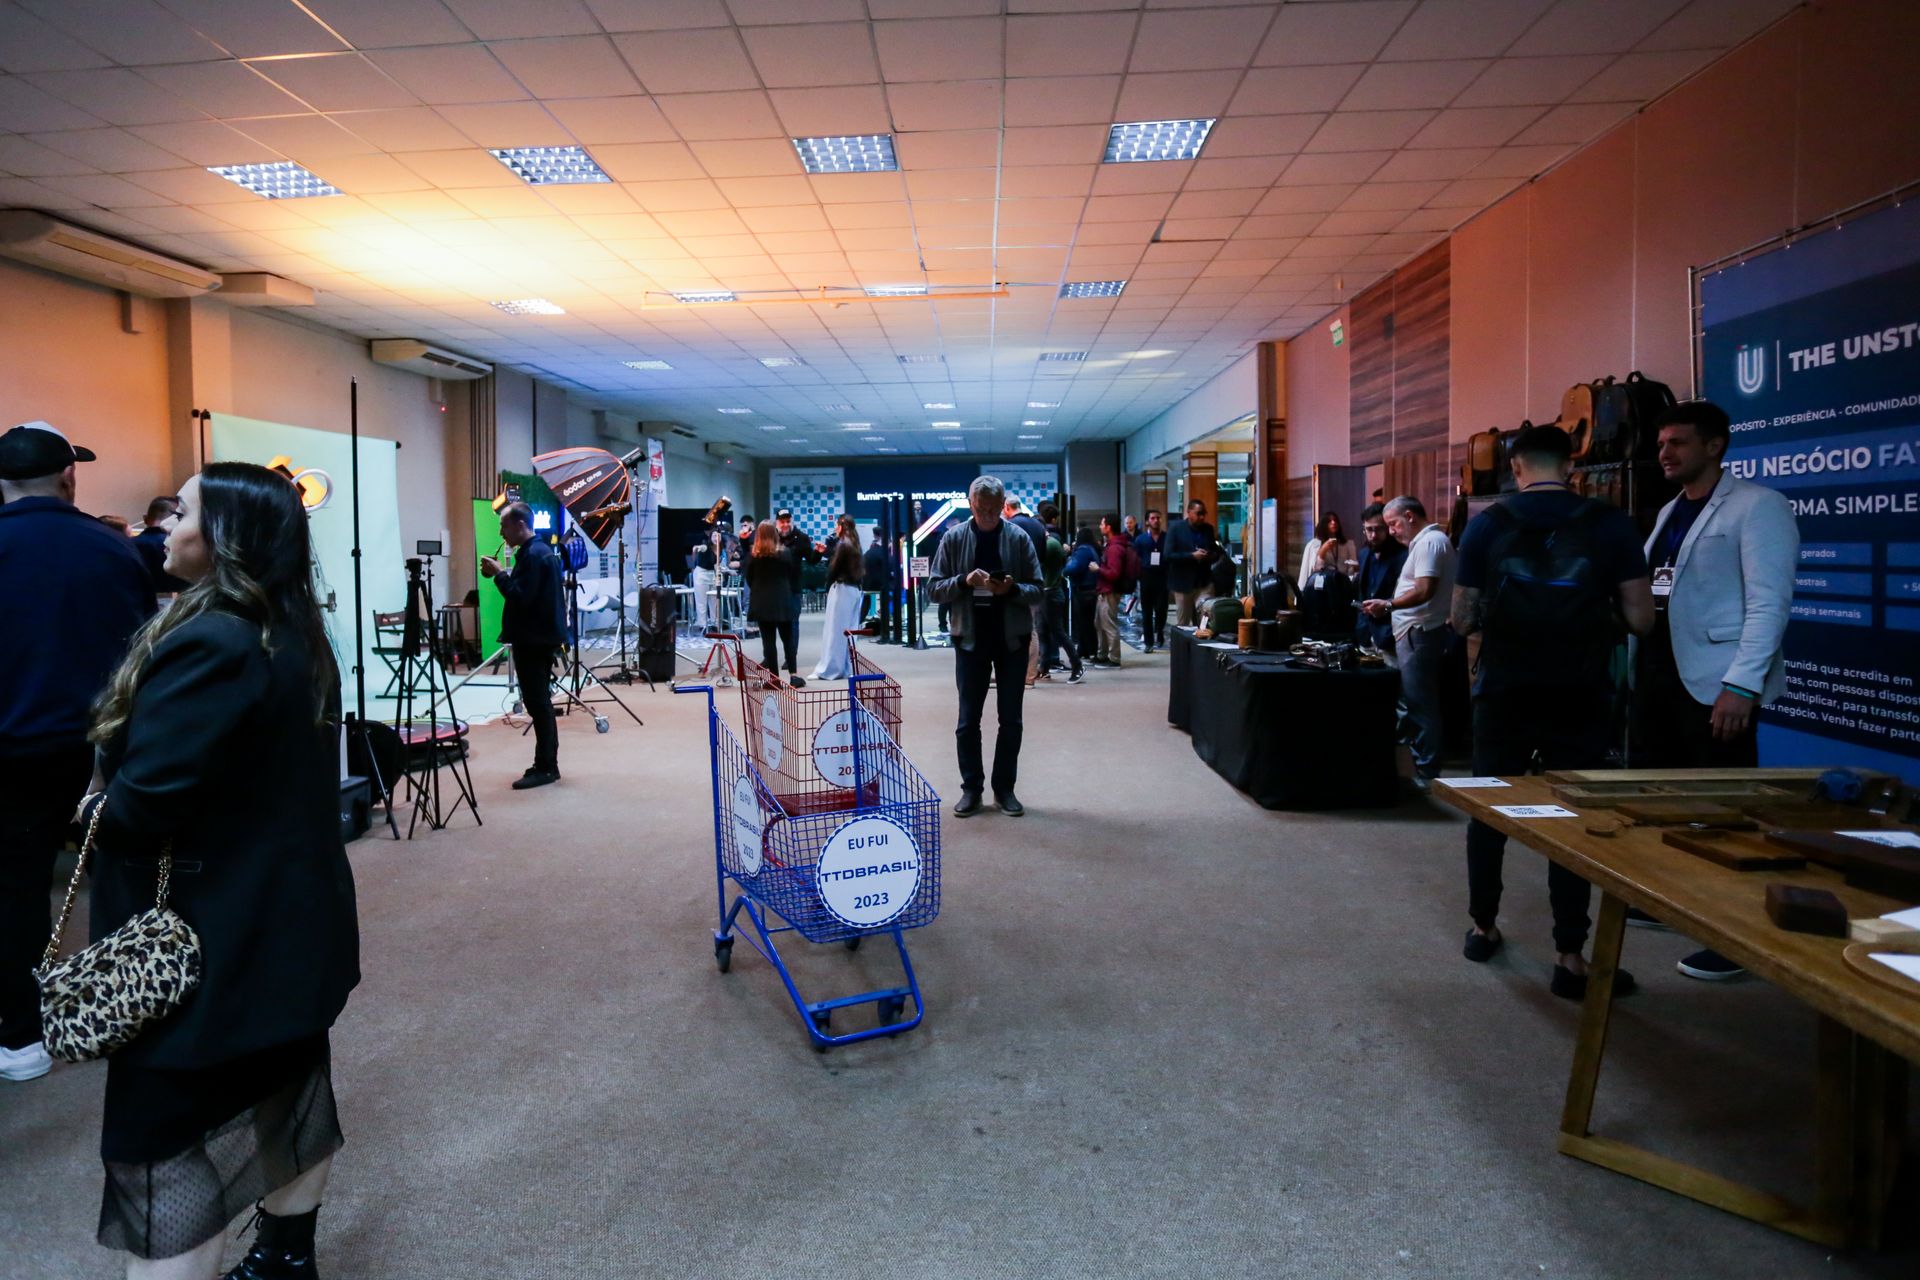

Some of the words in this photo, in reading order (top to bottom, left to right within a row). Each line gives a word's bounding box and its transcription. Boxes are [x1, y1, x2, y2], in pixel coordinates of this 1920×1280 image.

[1788, 342, 1836, 372] THE
[1843, 322, 1920, 360] UNST
[1773, 409, 1837, 428] EXPERIÊNCIA
[1845, 394, 1920, 416] COMUNIDAD
[1763, 446, 1872, 478] NEGÓCIO
[1878, 440, 1920, 467] FA
[1835, 493, 1920, 515] SIMPLE
[1801, 549, 1836, 560] gerados
[1818, 608, 1862, 620] semanais
[1820, 664, 1841, 676] que
[1843, 668, 1890, 684] acredita
[1893, 675, 1913, 687] em
[1807, 679, 1830, 690] com
[1832, 683, 1876, 699] pessoas
[1878, 690, 1920, 706] dispos
[1843, 701, 1868, 714] para
[836, 724, 849, 732] EU
[1778, 703, 1819, 721] negócio.
[1821, 712, 1856, 728] Venha
[1859, 719, 1887, 734] fazer
[848, 837, 865, 850] EU
[868, 834, 888, 847] FUI
[821, 861, 917, 882] TTDBRASIL
[854, 892, 889, 909] 2023
